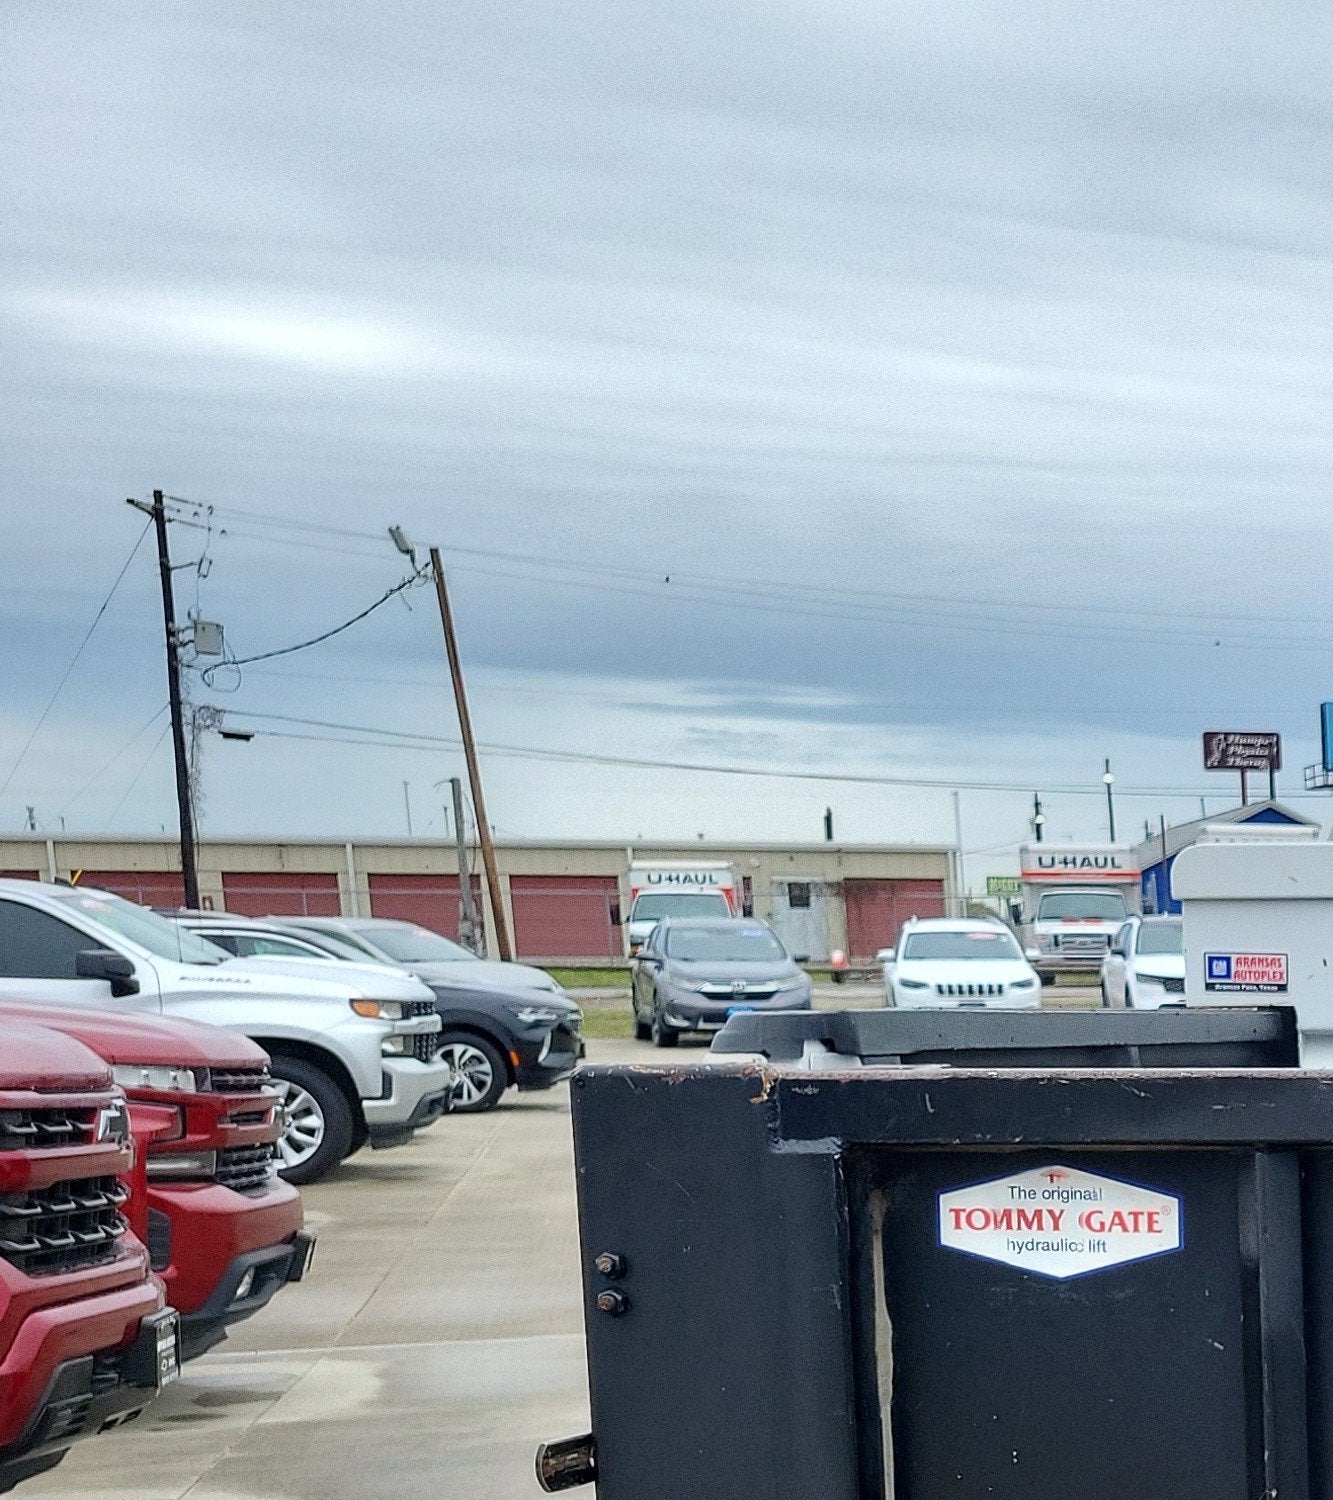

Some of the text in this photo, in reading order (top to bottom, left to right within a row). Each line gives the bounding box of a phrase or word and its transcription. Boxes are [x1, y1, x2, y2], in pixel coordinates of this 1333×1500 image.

[1038, 856, 1122, 869] U-HAUL
[647, 873, 718, 885] U-HAUL
[1235, 957, 1282, 968] ARANSAS
[1234, 970, 1285, 981] AUTOPLEX
[1008, 1186, 1103, 1203] The original
[949, 1208, 1163, 1233] TOMMY GATE
[1007, 1238, 1107, 1254] hydraulic lift
